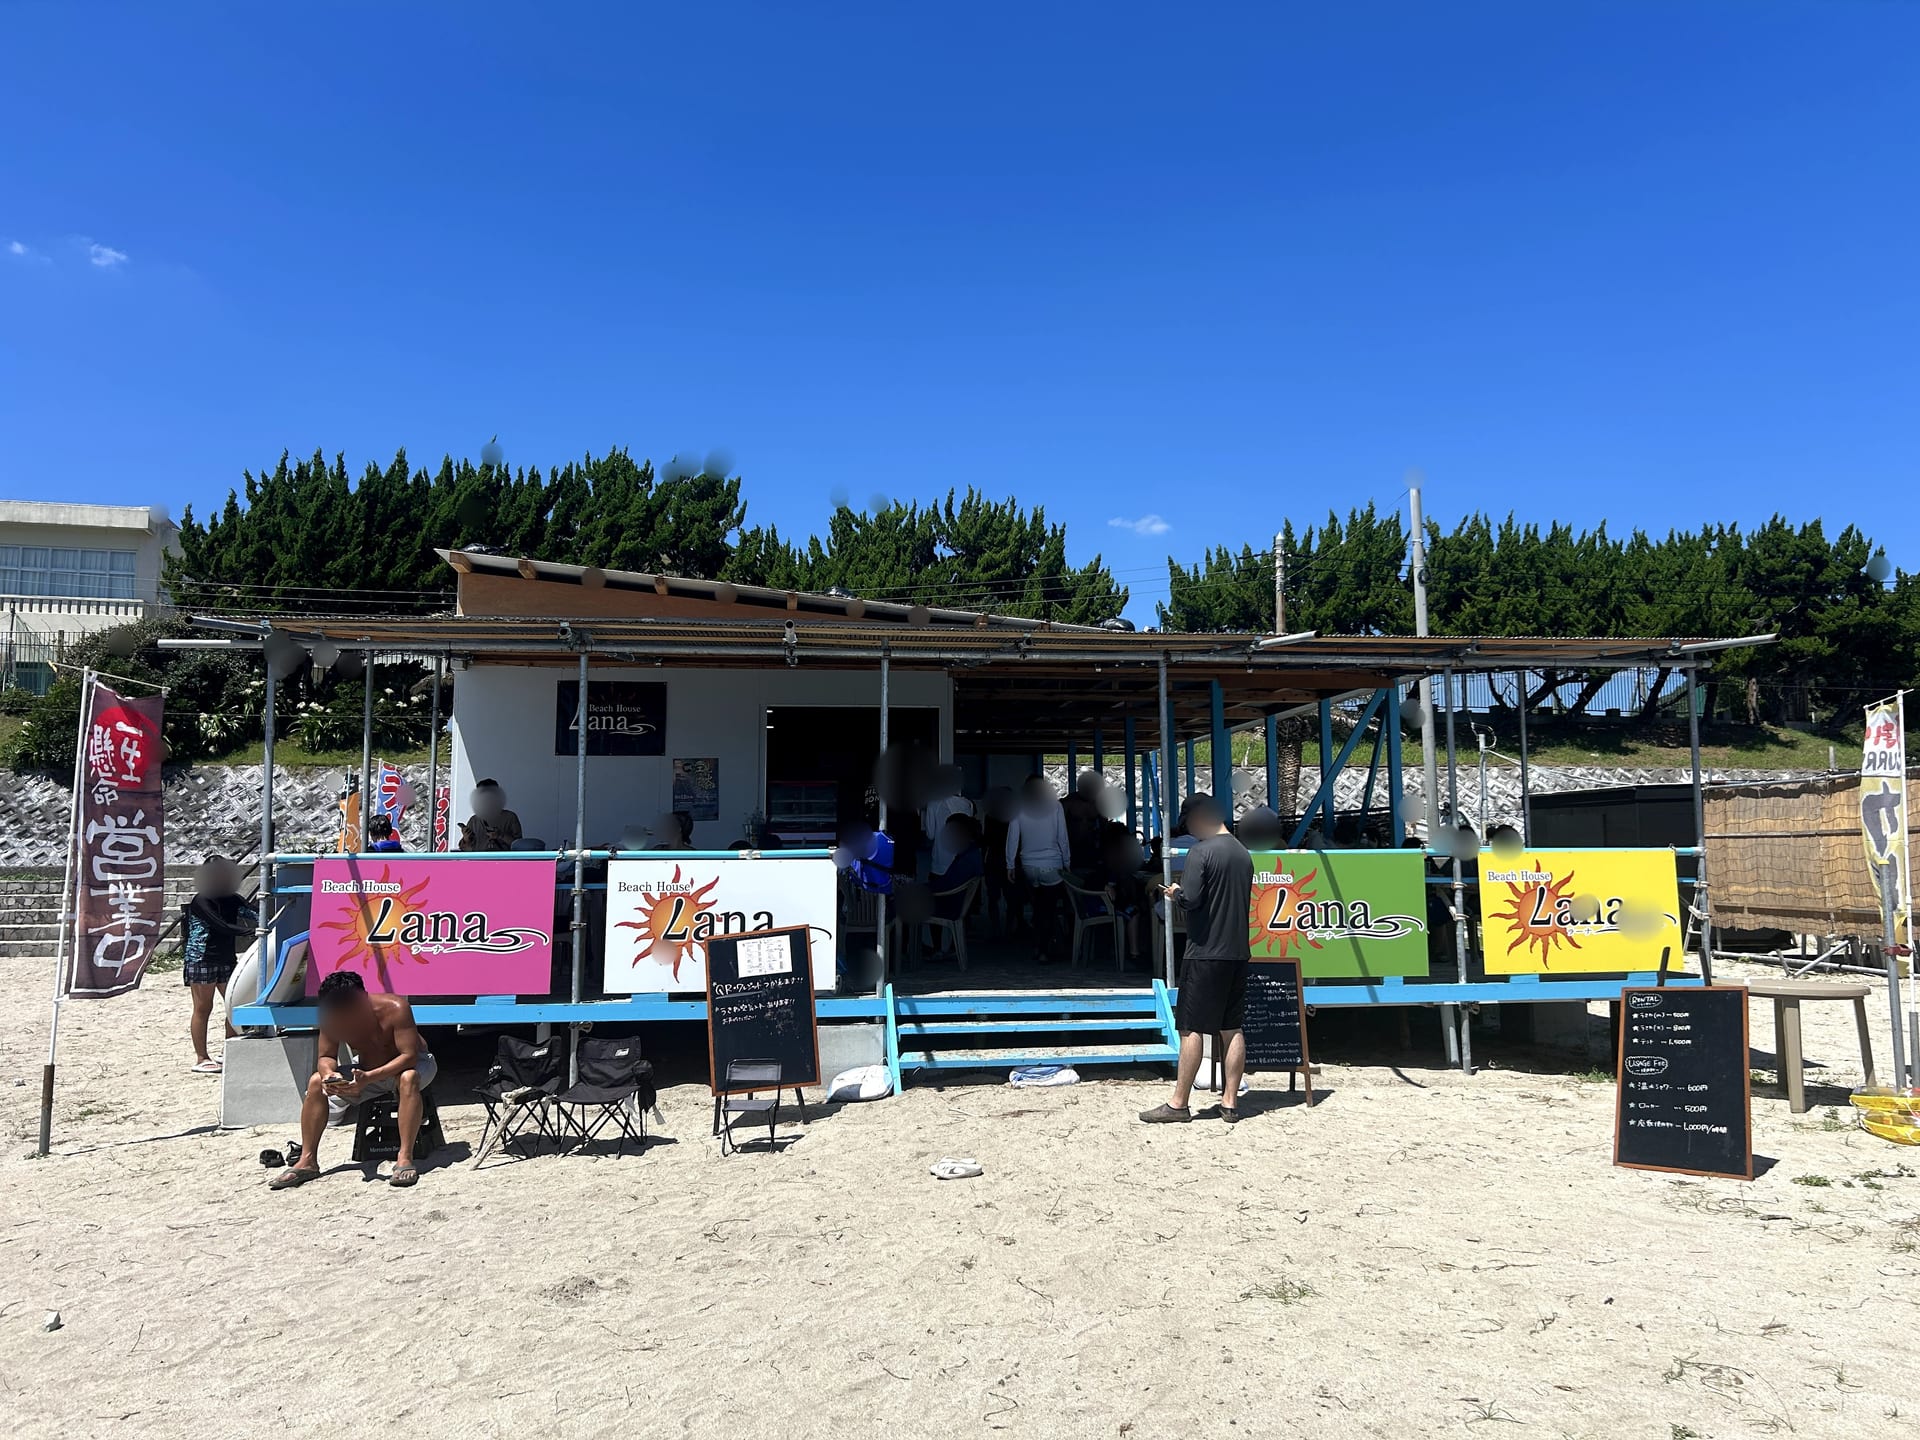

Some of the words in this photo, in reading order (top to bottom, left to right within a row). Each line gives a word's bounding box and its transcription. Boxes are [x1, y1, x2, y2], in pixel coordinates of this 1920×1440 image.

[589, 704, 613, 712] Beach
[616, 704, 641, 712] House
[1261, 873, 1292, 883] House
[1488, 871, 1517, 881] Beach
[1521, 871, 1551, 881] House
[323, 881, 359, 892] Beach
[363, 881, 400, 892] House
[618, 882, 652, 892] Beach
[657, 882, 691, 892] House
[86, 809, 162, 978] 営業中
[1269, 889, 1373, 930] Lana
[367, 899, 491, 943] Lana
[662, 898, 774, 941] Lana
[1307, 932, 1335, 940] ラーナ
[412, 945, 443, 954] ラーナ
[1628, 1060, 1651, 1068] USAGE
[1684, 1105, 1708, 1113] 500円
